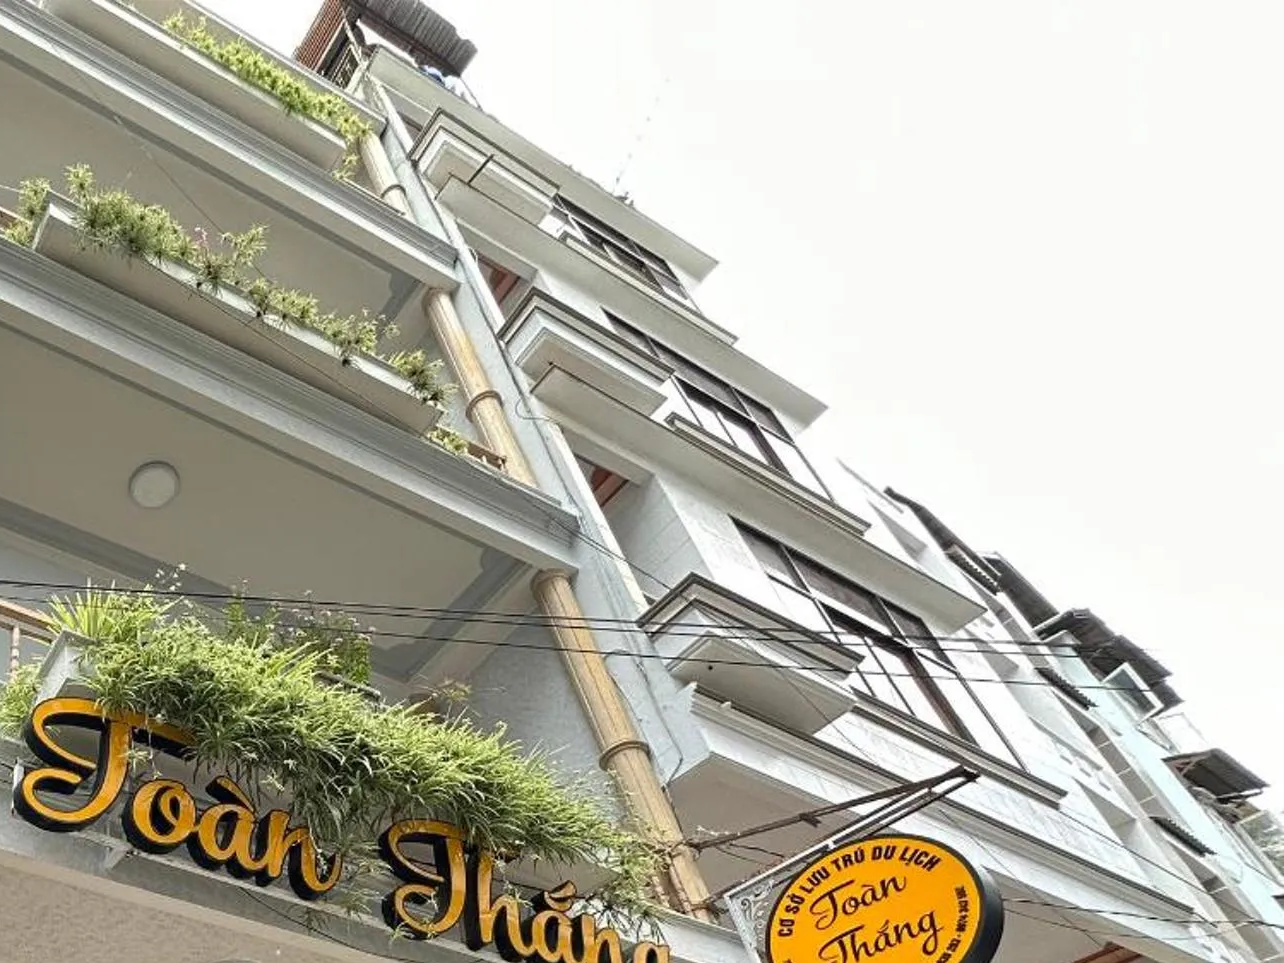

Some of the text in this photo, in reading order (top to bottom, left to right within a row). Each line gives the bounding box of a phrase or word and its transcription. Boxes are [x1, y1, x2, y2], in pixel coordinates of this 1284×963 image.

[13, 697, 343, 902] Toàn
[830, 846, 866, 872] TRÚ
[870, 845, 897, 861] DU
[898, 846, 942, 872] LỊCH
[809, 876, 907, 931] Toàn
